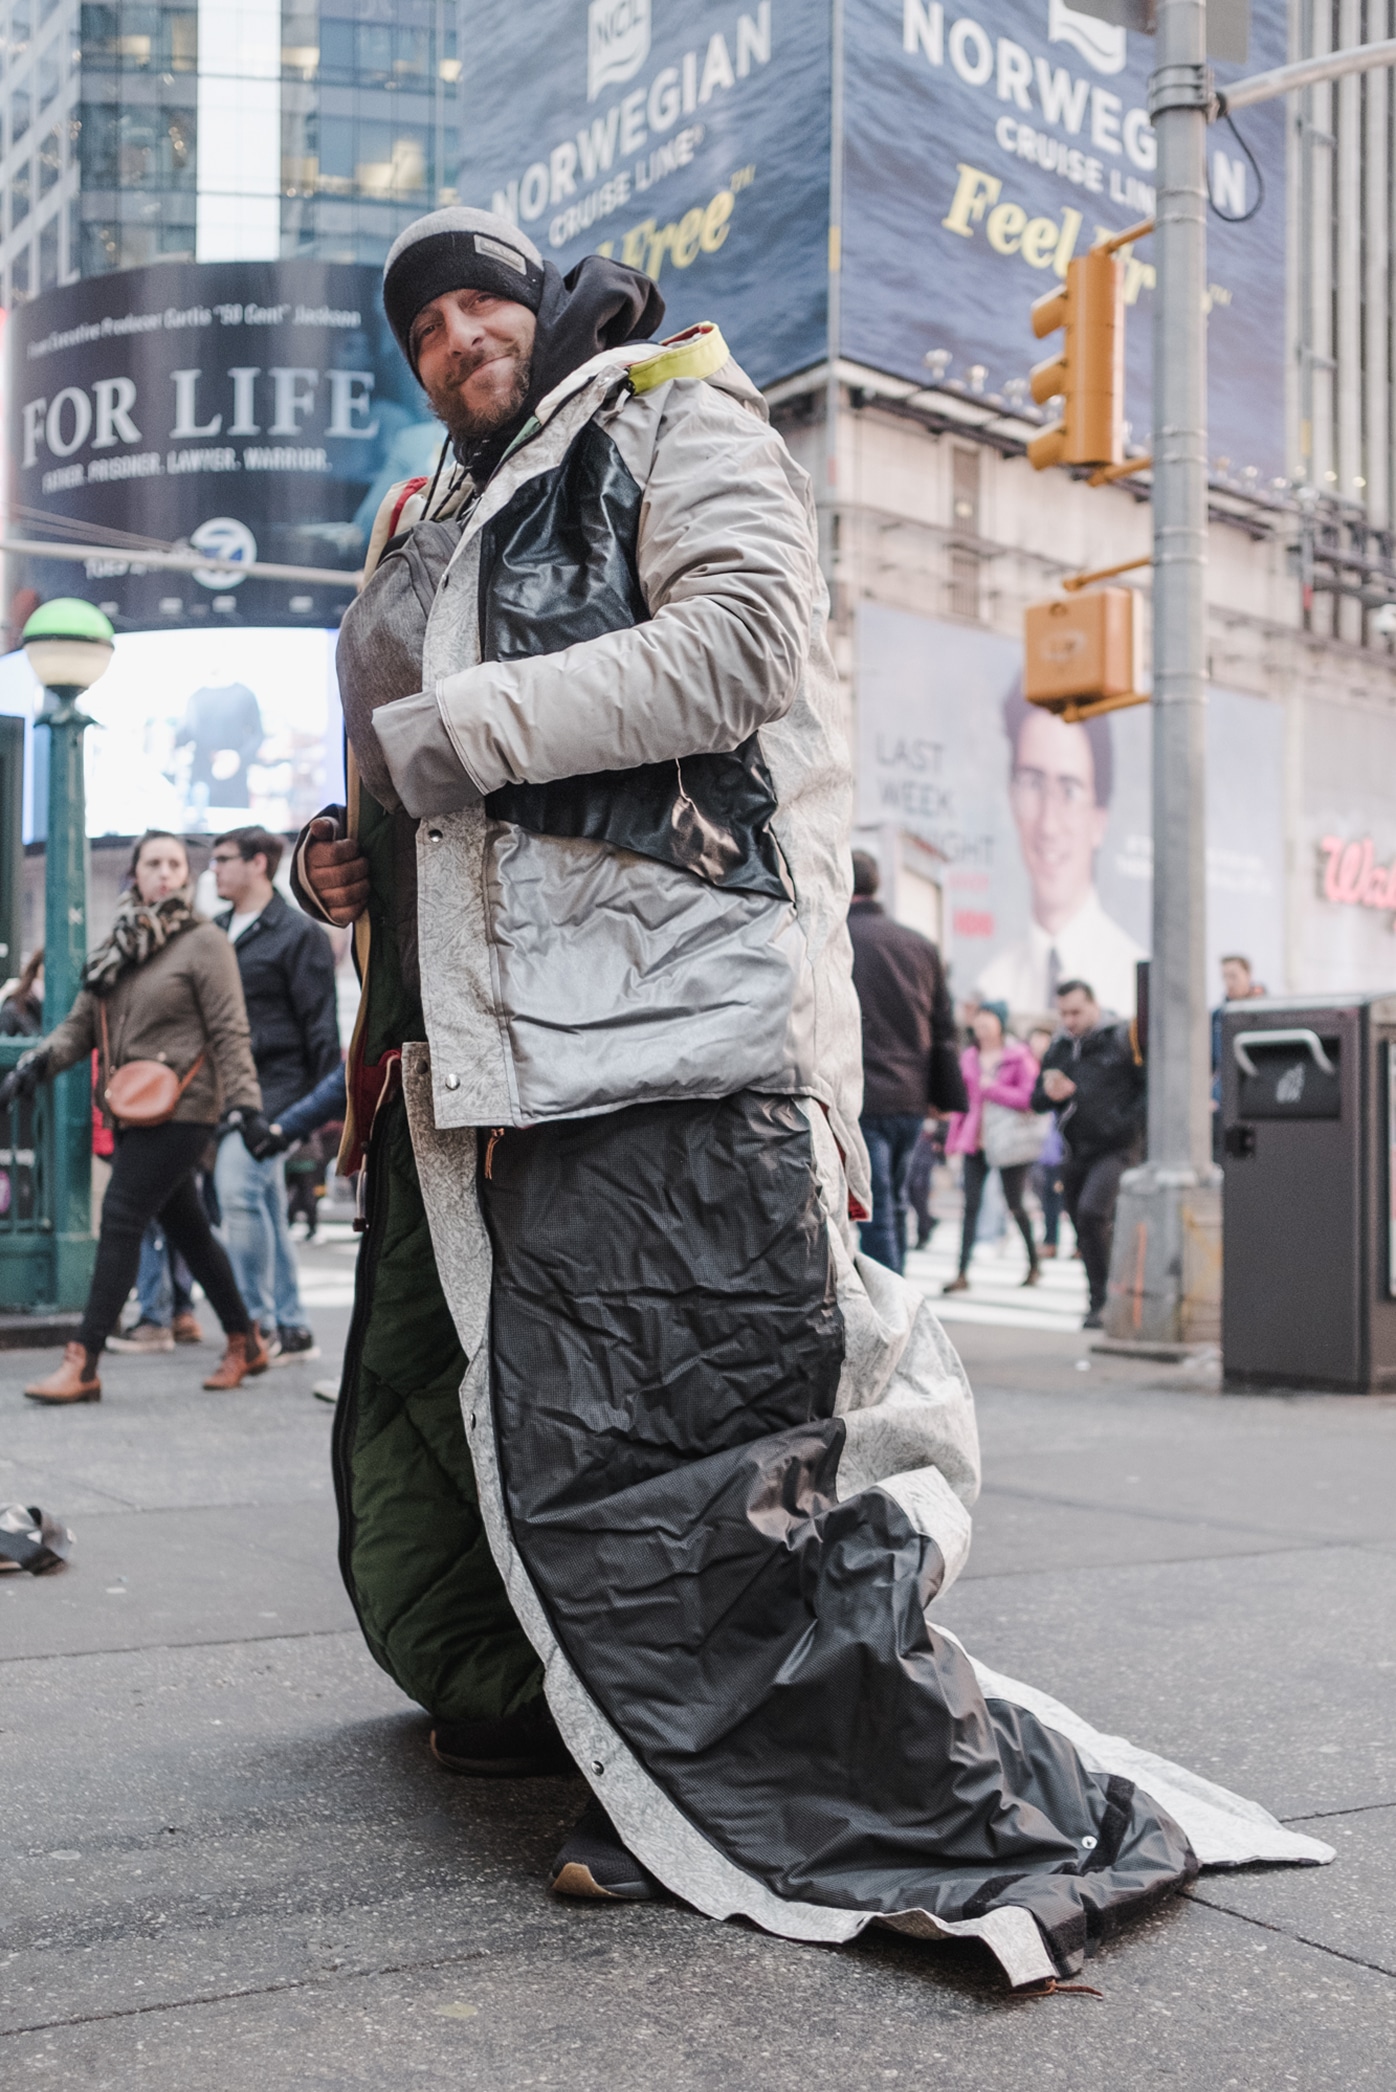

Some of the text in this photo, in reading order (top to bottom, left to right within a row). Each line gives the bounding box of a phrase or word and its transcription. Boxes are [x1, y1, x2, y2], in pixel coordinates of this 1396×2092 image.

[903, 0, 1247, 216] NORWEGN
[995, 115, 1104, 194] CRUISE
[548, 171, 632, 249] CRUISE
[941, 162, 1083, 279] Feel
[21, 366, 381, 471] FOR LIFE
[875, 732, 944, 776] LAST
[876, 778, 957, 821] WEEK
